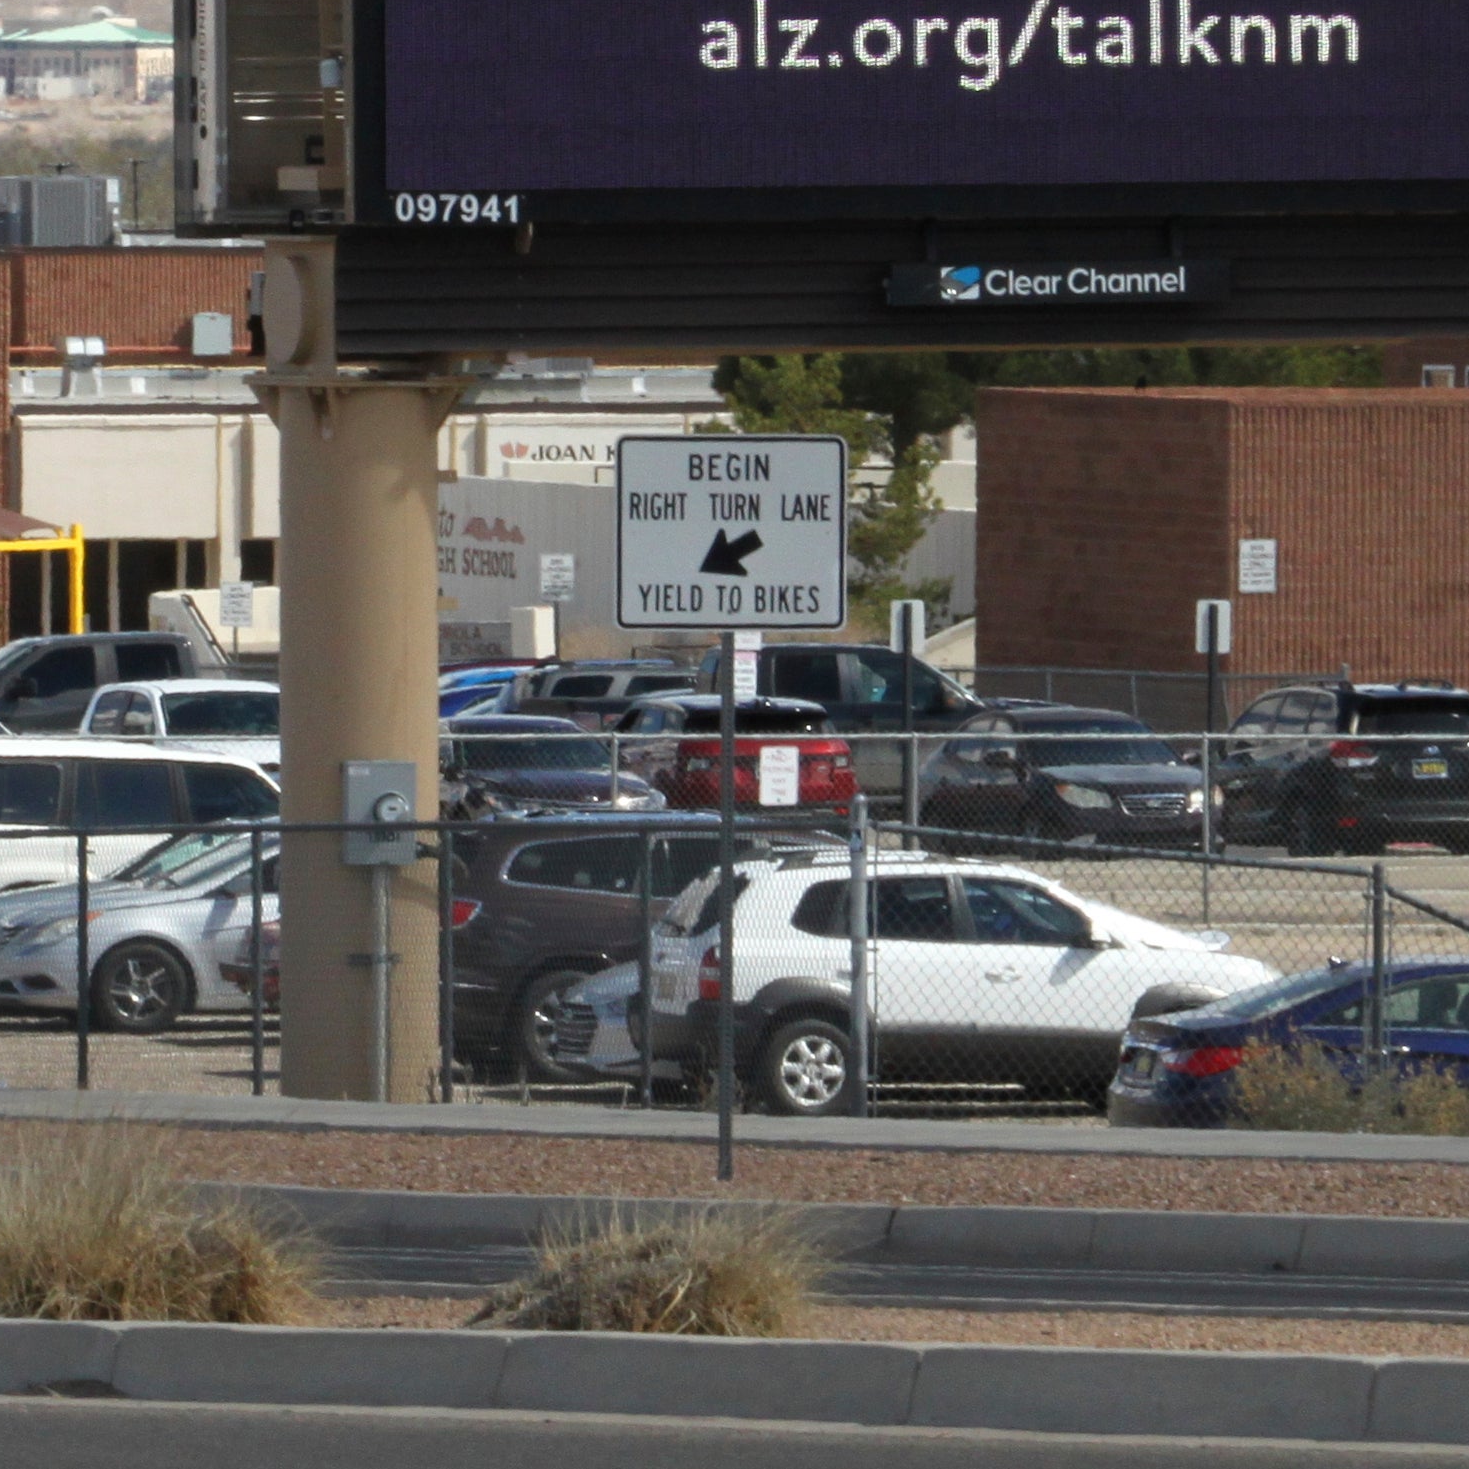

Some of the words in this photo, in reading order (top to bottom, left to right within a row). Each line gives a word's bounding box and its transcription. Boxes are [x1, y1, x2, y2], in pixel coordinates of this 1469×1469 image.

[395, 193, 519, 223] 097941
[985, 269, 1062, 296] Clear
[1067, 266, 1185, 294] Channel
[532, 444, 595, 462] JOAN
[688, 453, 771, 482] BEGIN
[629, 492, 687, 521] RIGHT
[709, 493, 760, 521] TURN
[781, 494, 831, 522] LANE
[463, 549, 517, 579] SCHOOL
[638, 584, 703, 612] YIELD
[716, 585, 743, 613] TO
[754, 585, 820, 613] BIKES
